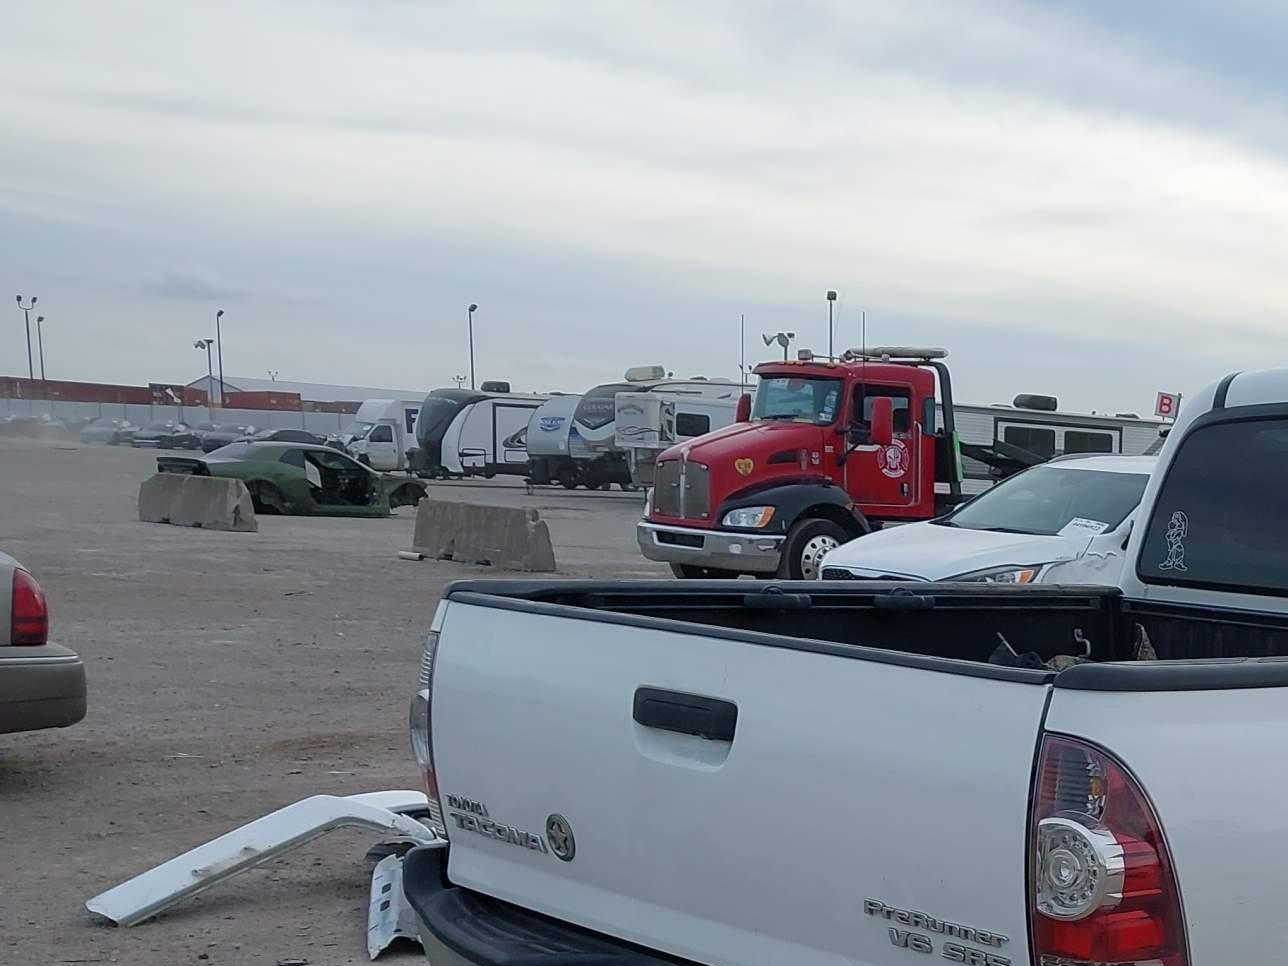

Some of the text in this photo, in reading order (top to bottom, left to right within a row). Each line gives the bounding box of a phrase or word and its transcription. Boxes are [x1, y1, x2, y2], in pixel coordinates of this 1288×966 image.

[1159, 395, 1172, 414] B
[446, 794, 490, 817] TOYOTA
[449, 812, 549, 855] TACOMA
[863, 897, 1010, 948] PreRunner
[888, 926, 934, 954] V6
